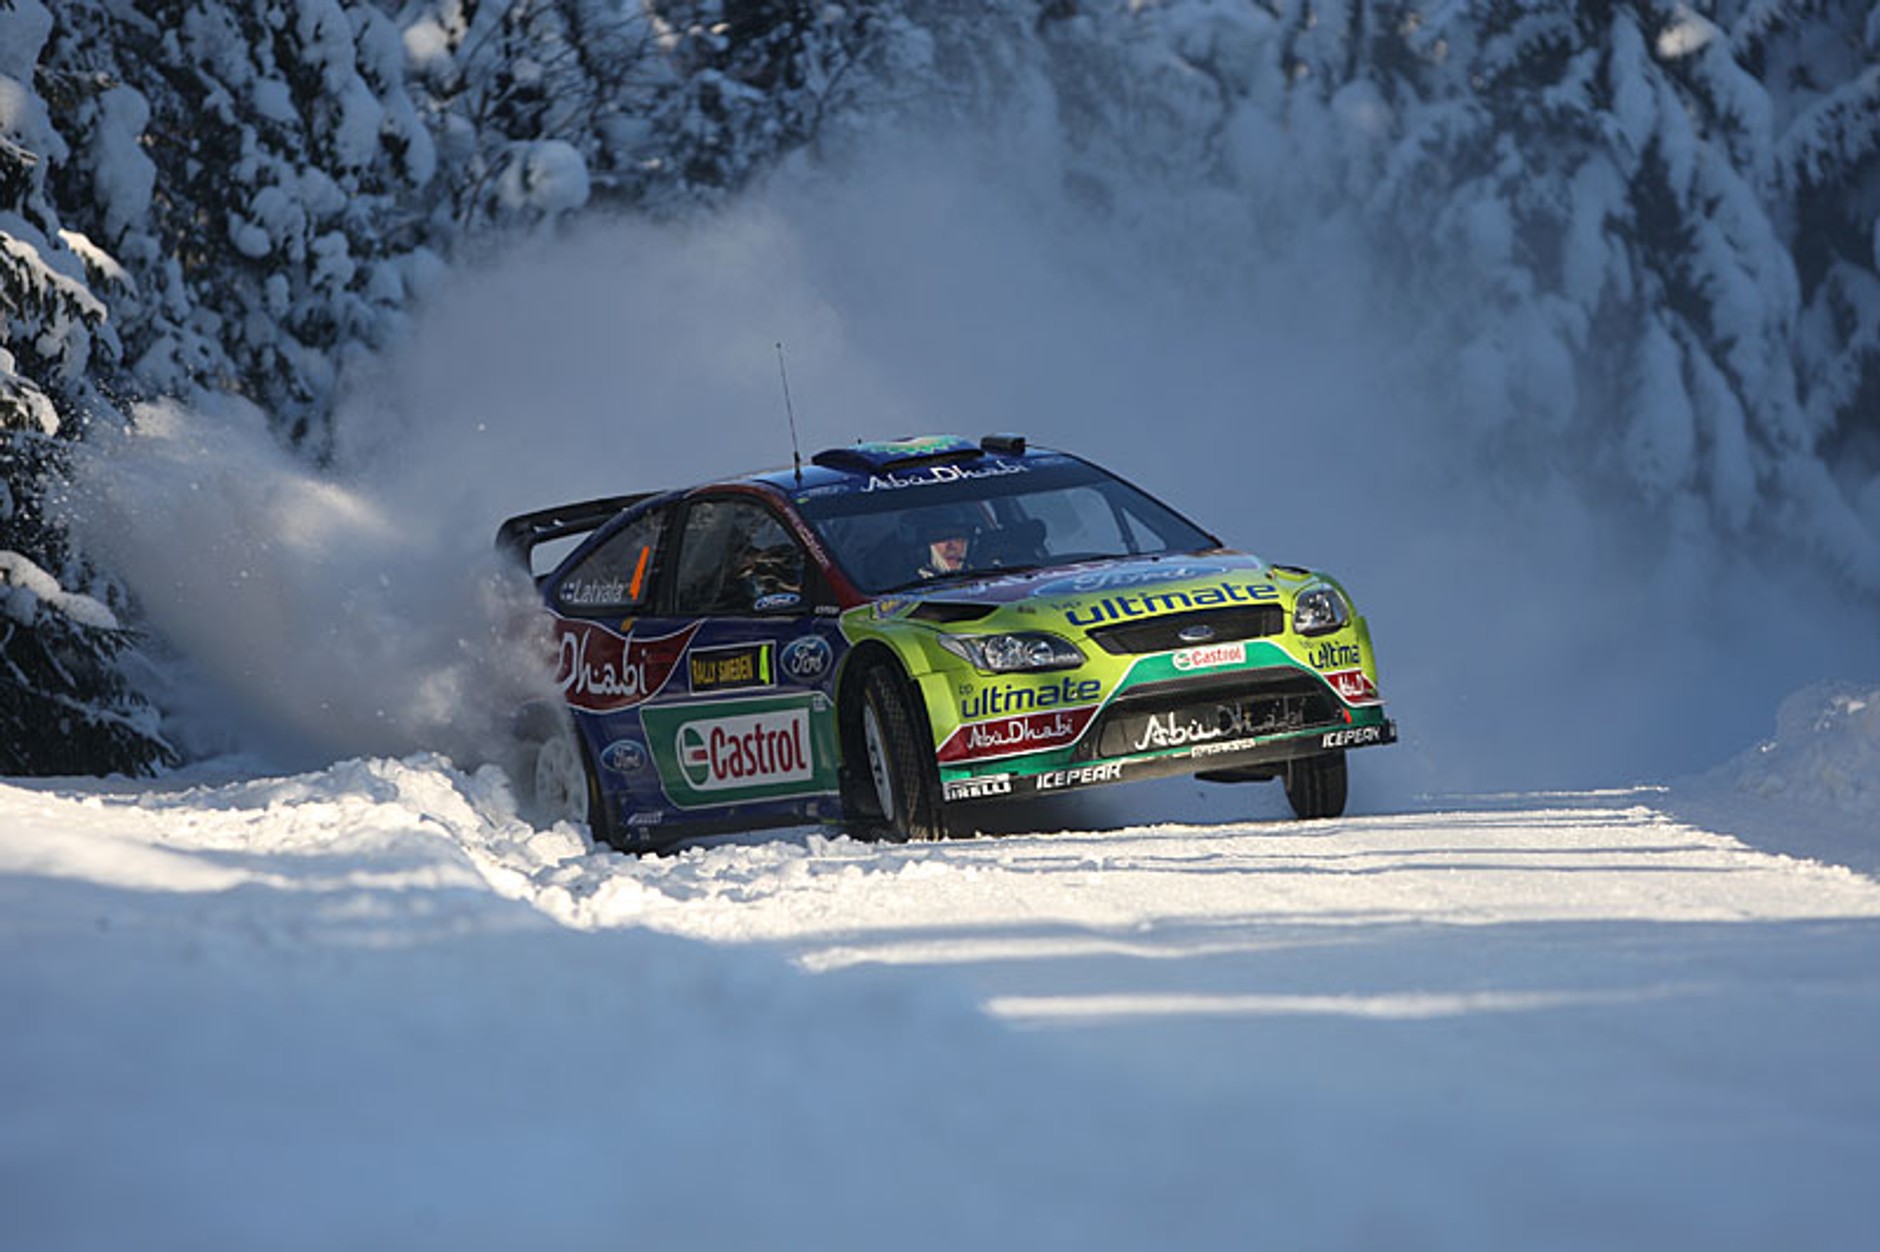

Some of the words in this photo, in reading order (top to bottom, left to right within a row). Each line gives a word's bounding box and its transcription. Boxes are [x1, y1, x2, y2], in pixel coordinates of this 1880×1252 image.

[861, 475, 937, 493] Abu
[929, 460, 1030, 484] Dhabi
[1065, 583, 1279, 626] ultimate
[555, 627, 648, 696] Dhabi
[692, 659, 715, 684] RALLY
[718, 653, 753, 682] SWEDEN
[791, 643, 824, 673] Ford
[1191, 646, 1242, 667] Castrol
[962, 677, 1101, 718] ultimate
[966, 724, 1009, 749] Abu
[1008, 714, 1073, 744] Dhabi
[1135, 711, 1221, 750] Abu
[710, 719, 806, 780] Castrol
